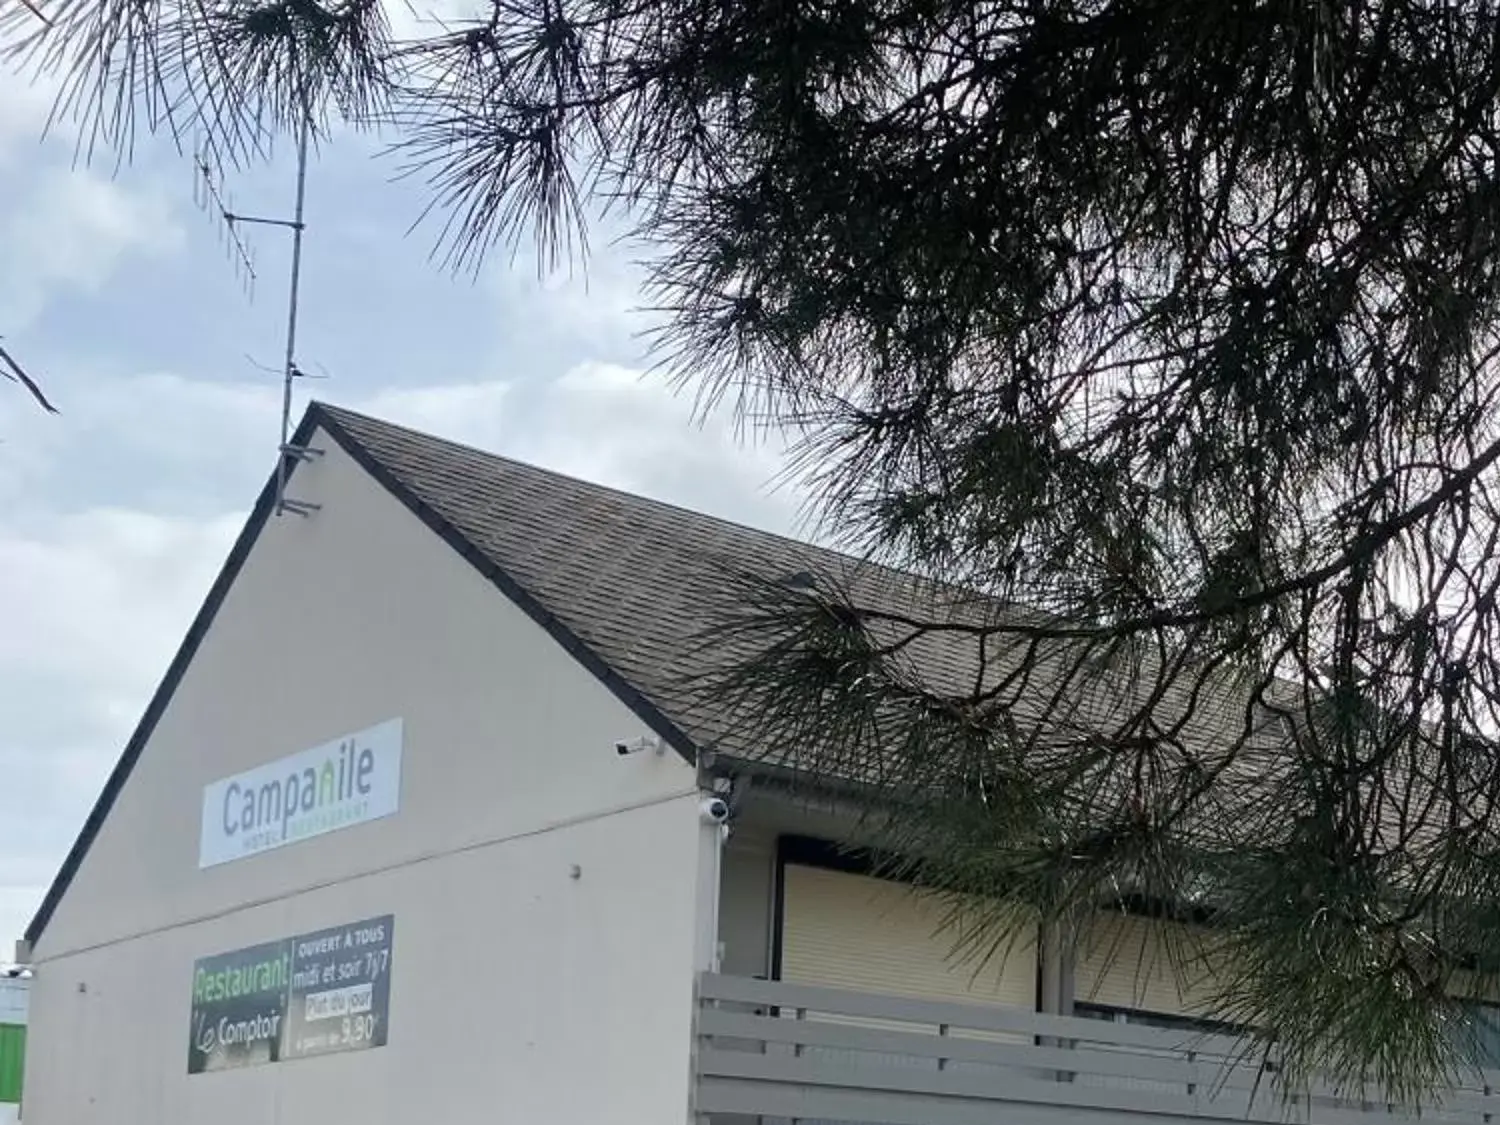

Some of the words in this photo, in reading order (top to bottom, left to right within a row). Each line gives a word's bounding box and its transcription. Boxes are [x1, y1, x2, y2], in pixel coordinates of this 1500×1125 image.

[222, 738, 374, 840] Campanile
[299, 934, 340, 958] OUVERT
[354, 925, 384, 946] TOUS
[195, 952, 288, 1003] Restaurant
[294, 963, 319, 989] midi
[322, 957, 336, 984] et
[338, 955, 362, 980] soir
[219, 1009, 281, 1050] Comptoir
